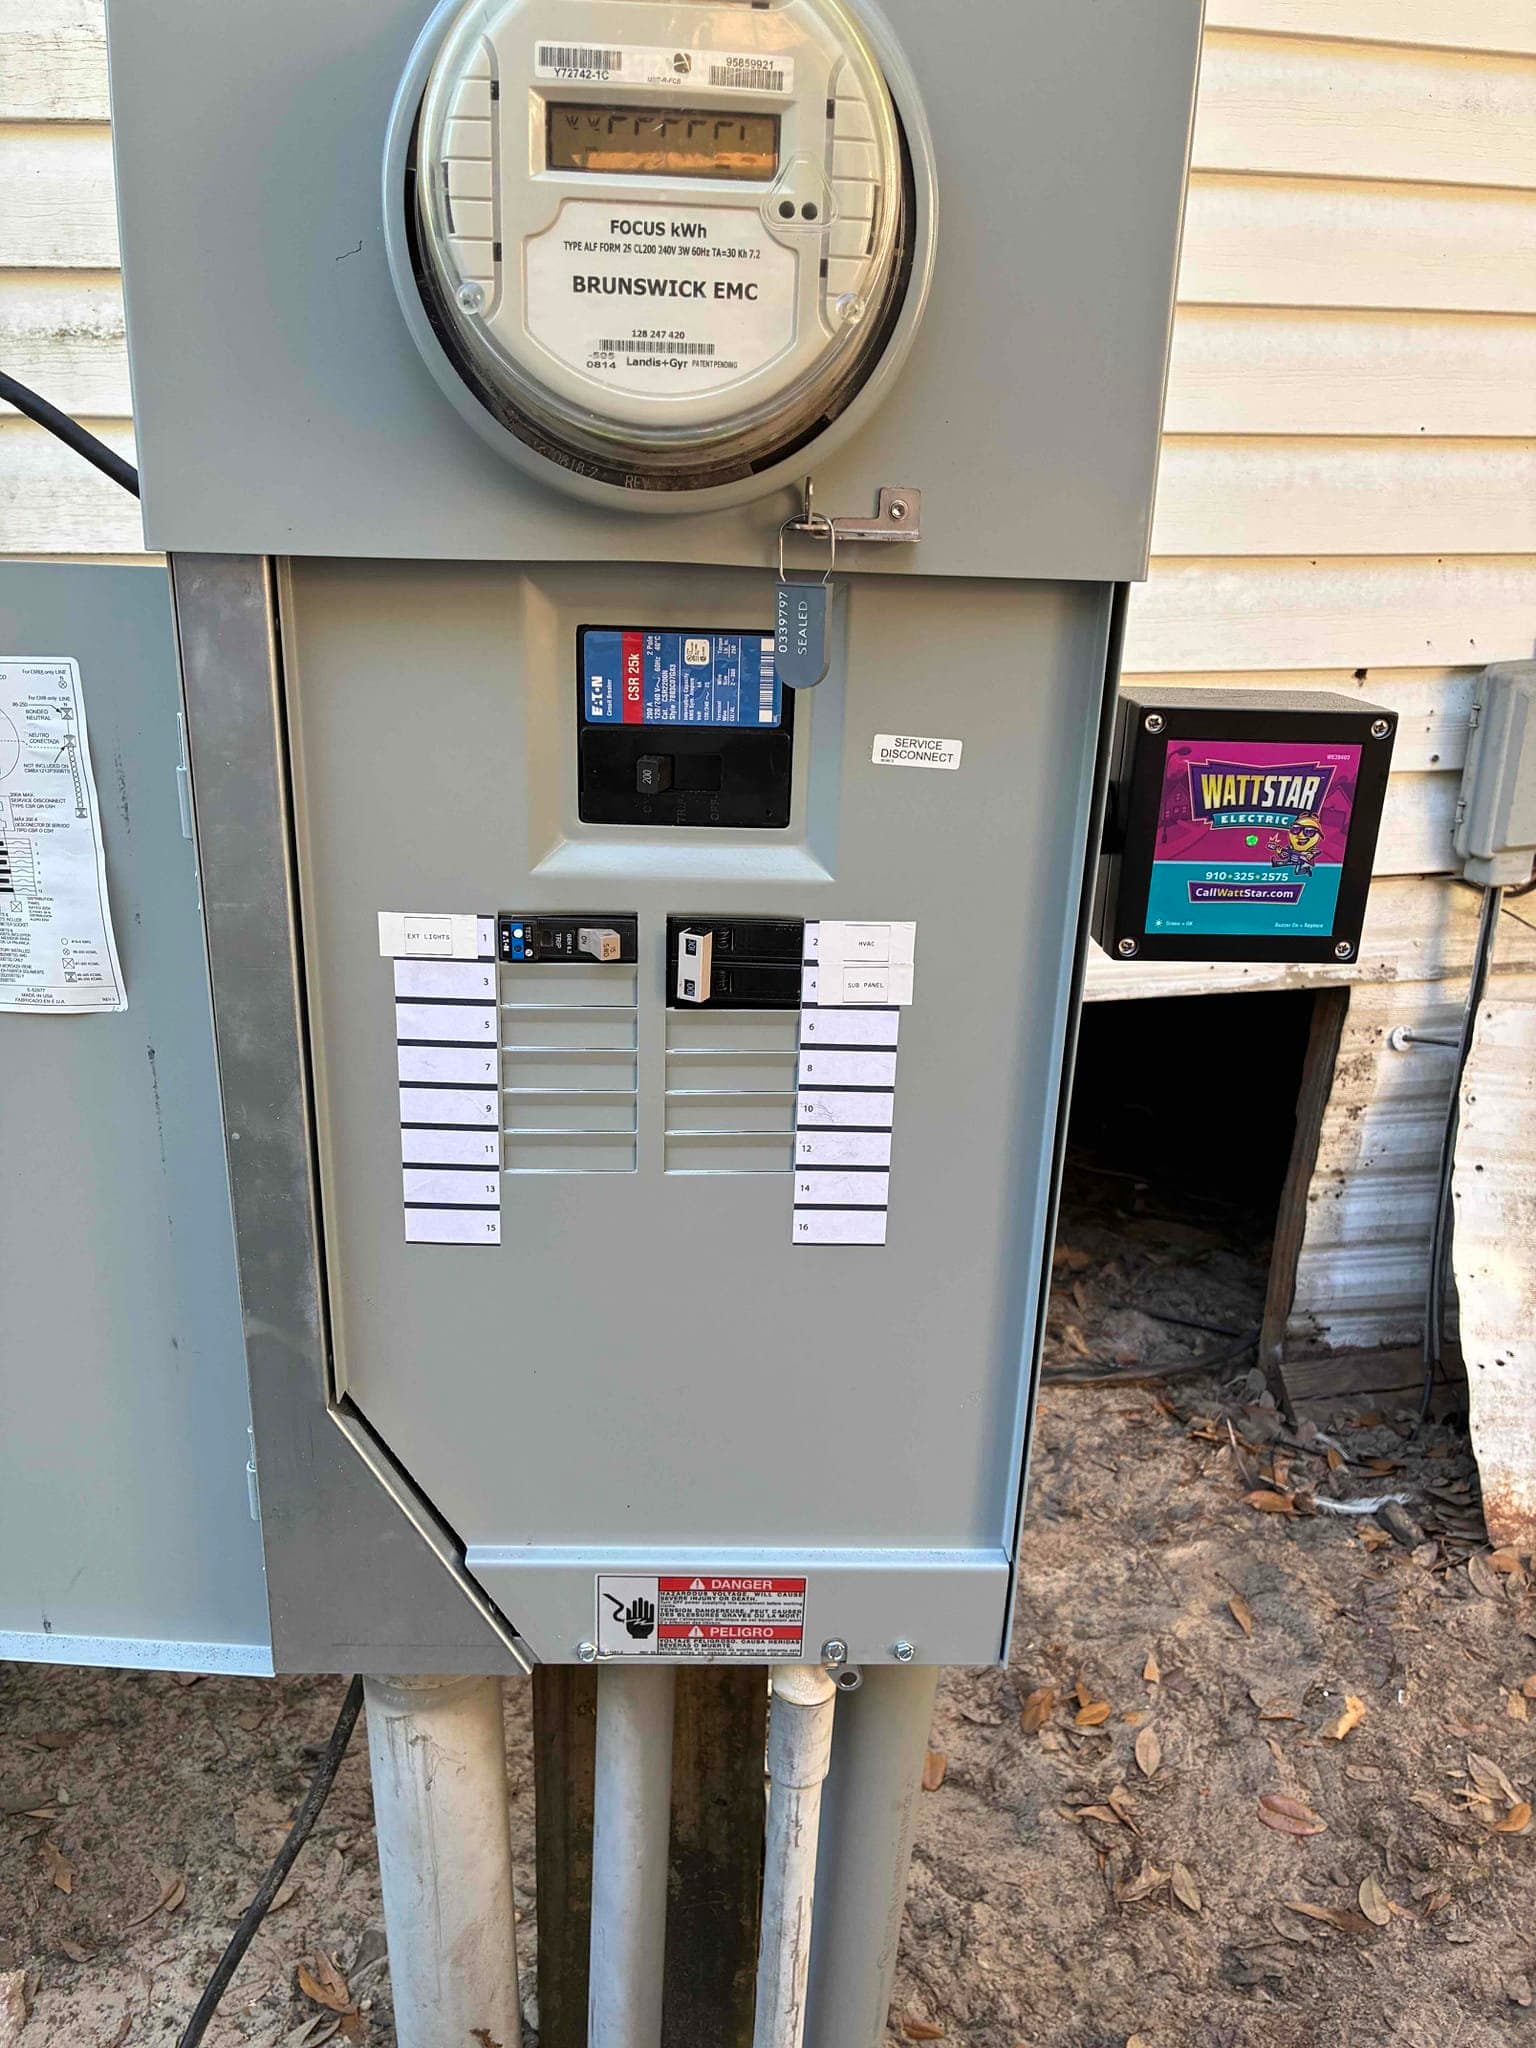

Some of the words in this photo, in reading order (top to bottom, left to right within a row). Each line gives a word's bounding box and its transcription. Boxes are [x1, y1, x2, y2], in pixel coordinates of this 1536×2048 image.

[726, 57, 774, 70] 95859921
[554, 68, 610, 81] Y72742-1C
[610, 220, 665, 236] FOCUS
[671, 222, 707, 239] kWh
[564, 241, 582, 251] TYPE
[584, 241, 598, 252] ALF
[600, 242, 621, 253] FORM
[634, 243, 656, 254] CL200
[658, 245, 676, 256] 240V
[678, 246, 690, 256] 3W
[692, 247, 710, 257] 60Hz
[712, 247, 736, 258] TA=30
[738, 248, 747, 258] Kh
[749, 249, 760, 259] 7.2
[573, 275, 707, 299] BRUNSWICK
[714, 281, 759, 301] EMC
[632, 329, 648, 338] 128
[650, 330, 666, 339] 247
[668, 331, 685, 340] 420
[586, 361, 616, 369] 0814
[626, 356, 688, 370] Landis+Gyr
[692, 360, 713, 369] PATENT
[778, 591, 788, 653] 0339797
[798, 601, 808, 655] SEALED
[628, 653, 640, 674] 25k
[628, 677, 640, 701] CSR
[894, 737, 943, 751] SERVICE
[880, 748, 954, 763] DISCONNECT
[642, 769, 652, 784] 200
[1201, 773, 1321, 811] WATTSTAR
[1220, 814, 1289, 825] ELECTRIC
[1195, 888, 1294, 898] CallWattStar.com
[407, 932, 420, 940] EXT
[482, 933, 487, 942] 1
[581, 935, 587, 945] ON
[813, 938, 819, 946] 2
[483, 977, 489, 986] 3
[811, 981, 816, 989] 4
[484, 1021, 490, 1029] 5
[808, 1023, 814, 1031] 6
[485, 1063, 491, 1071] 7
[807, 1064, 813, 1072] 8
[486, 1104, 492, 1113] 9
[803, 1104, 814, 1113] 10
[484, 1145, 494, 1153] 11
[802, 1145, 812, 1153] 12
[485, 1185, 496, 1193] 13
[800, 1184, 810, 1192] 14
[486, 1224, 496, 1232] 15
[798, 1223, 809, 1231] 16
[711, 1579, 773, 1590] DANGER
[710, 1627, 774, 1638] PELIGRO
